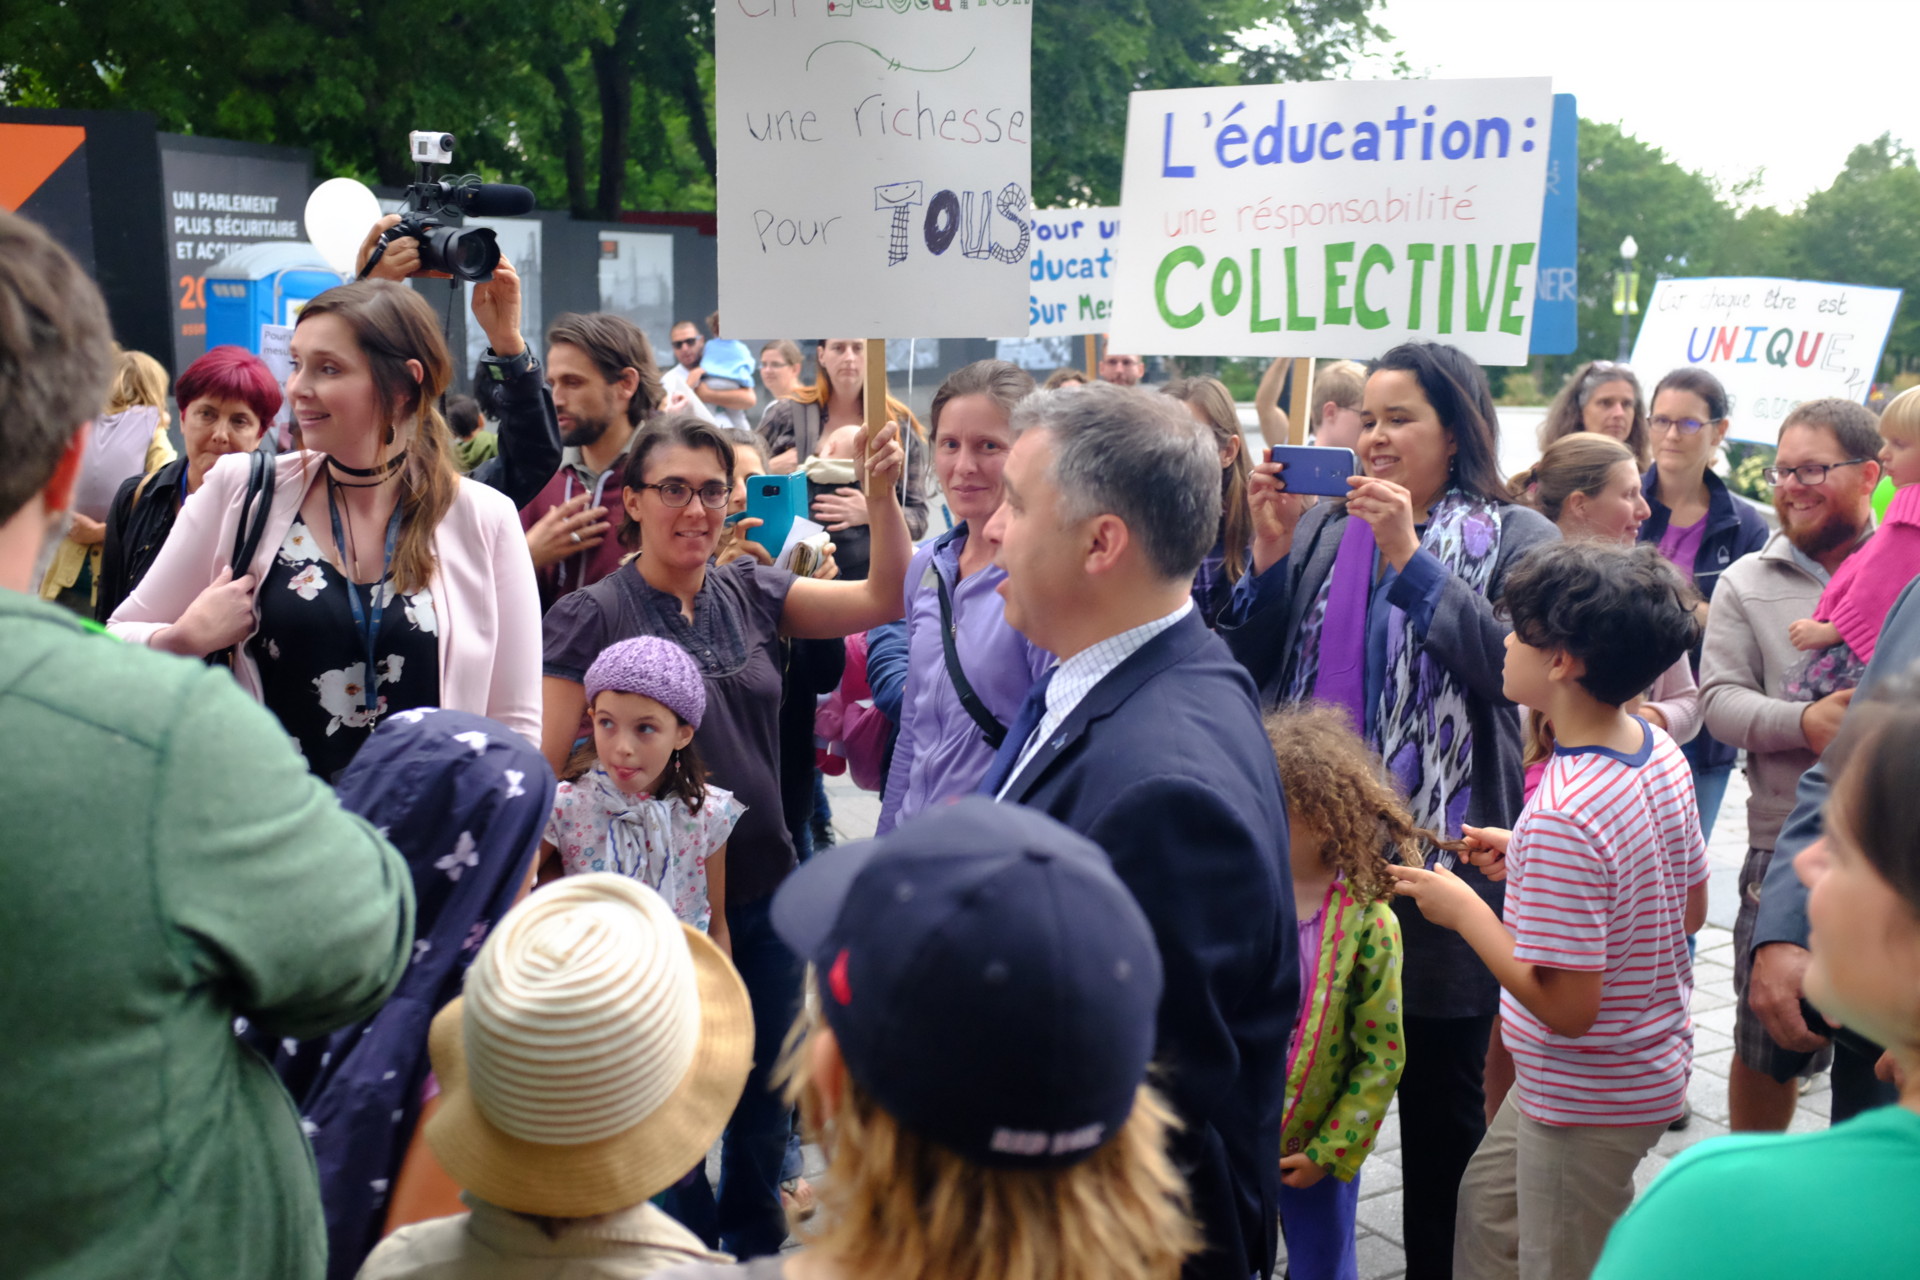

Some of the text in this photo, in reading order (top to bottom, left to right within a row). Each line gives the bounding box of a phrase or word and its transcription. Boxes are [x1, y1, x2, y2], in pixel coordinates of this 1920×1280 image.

[746, 90, 1027, 144] une richesse
[172, 191, 278, 214] UN PARLEMENT
[1164, 184, 1478, 238] une résponsabilité
[174, 214, 298, 238] PLUS SÉCURITAIRE
[874, 181, 1031, 267] TOUS
[1099, 219, 1120, 240] u
[176, 241, 194, 260] ET
[1030, 247, 1115, 282] ducat
[1818, 292, 1848, 316] est
